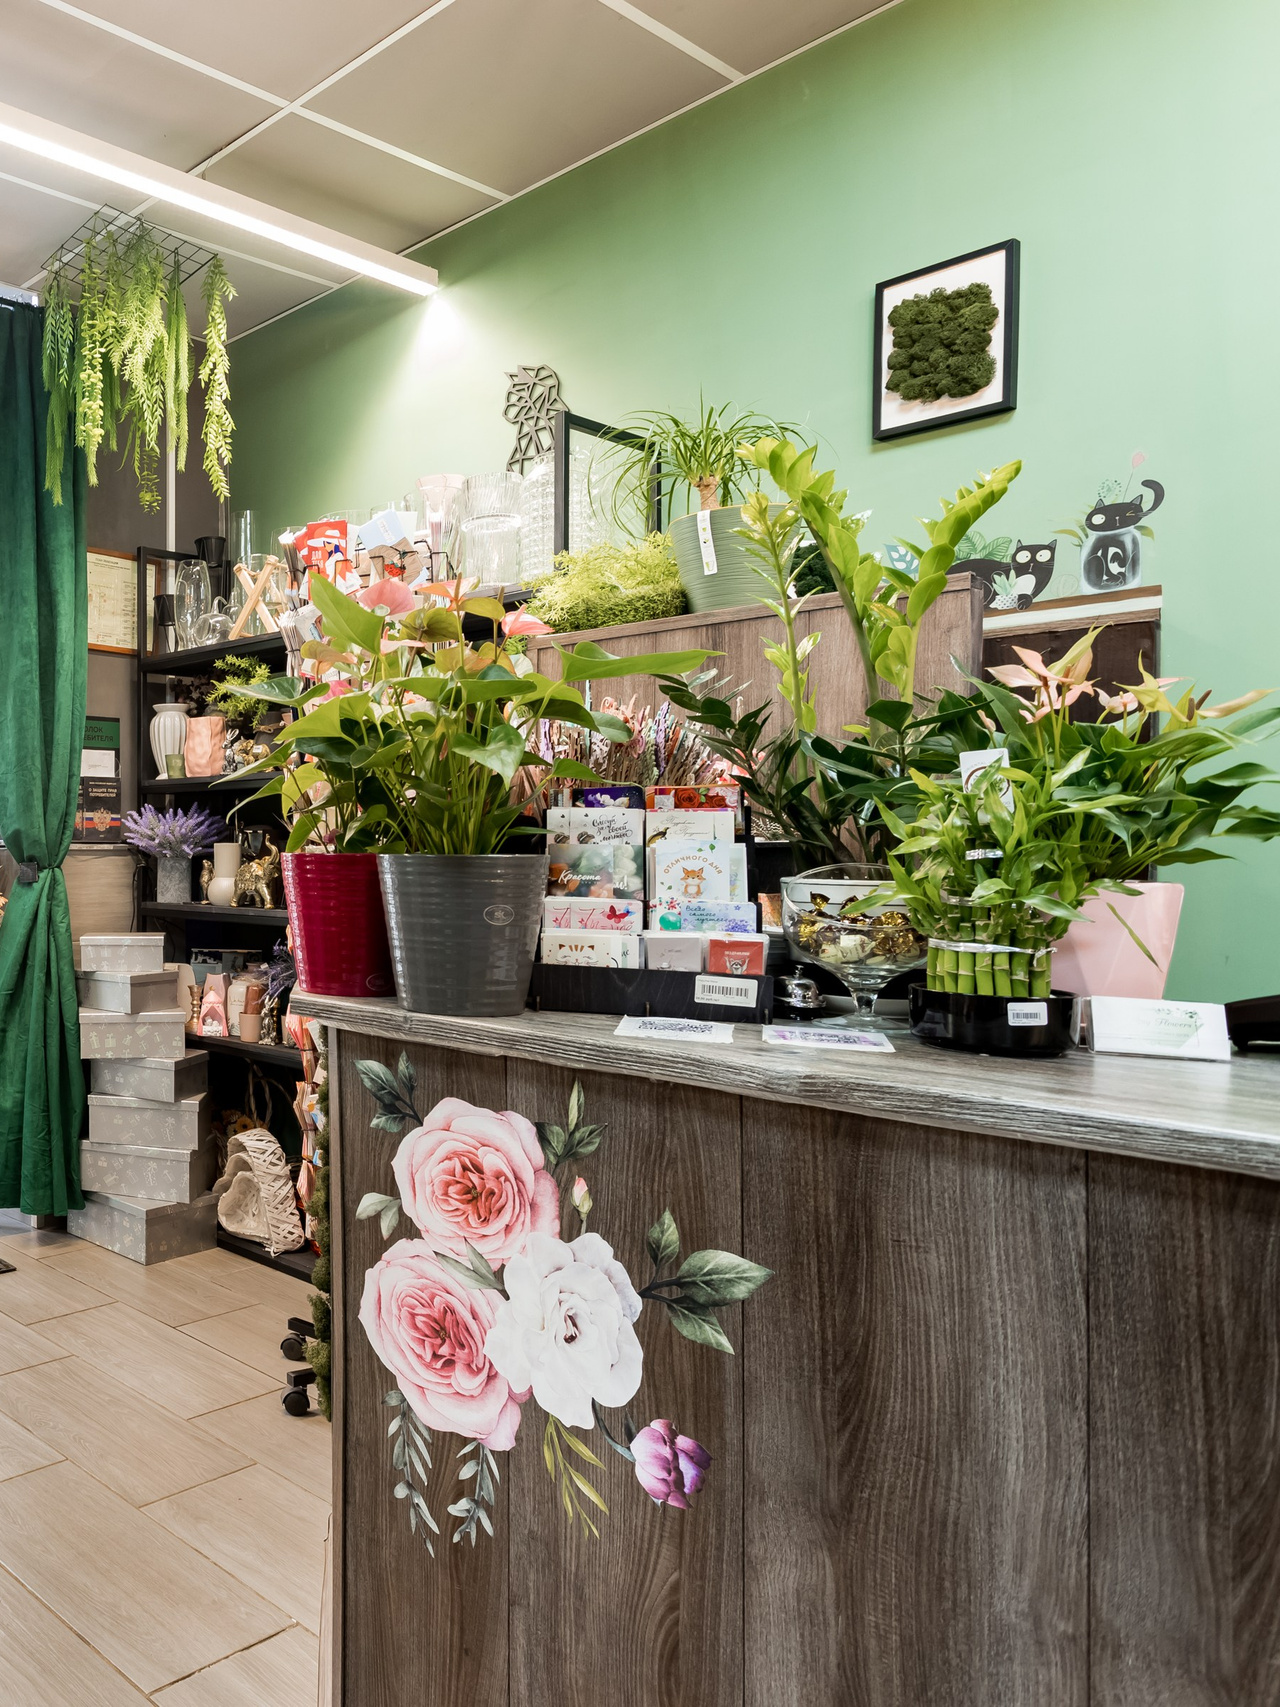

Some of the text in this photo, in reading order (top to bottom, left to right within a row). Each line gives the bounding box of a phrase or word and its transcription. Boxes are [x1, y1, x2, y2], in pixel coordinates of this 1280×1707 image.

[85, 725, 103, 733] ОЛОК
[84, 734, 114, 742] ЕБИТЕЛЯ
[663, 855, 723, 875] ОТЛИЧНОГО ДНЯ
[558, 869, 602, 884] Красота
